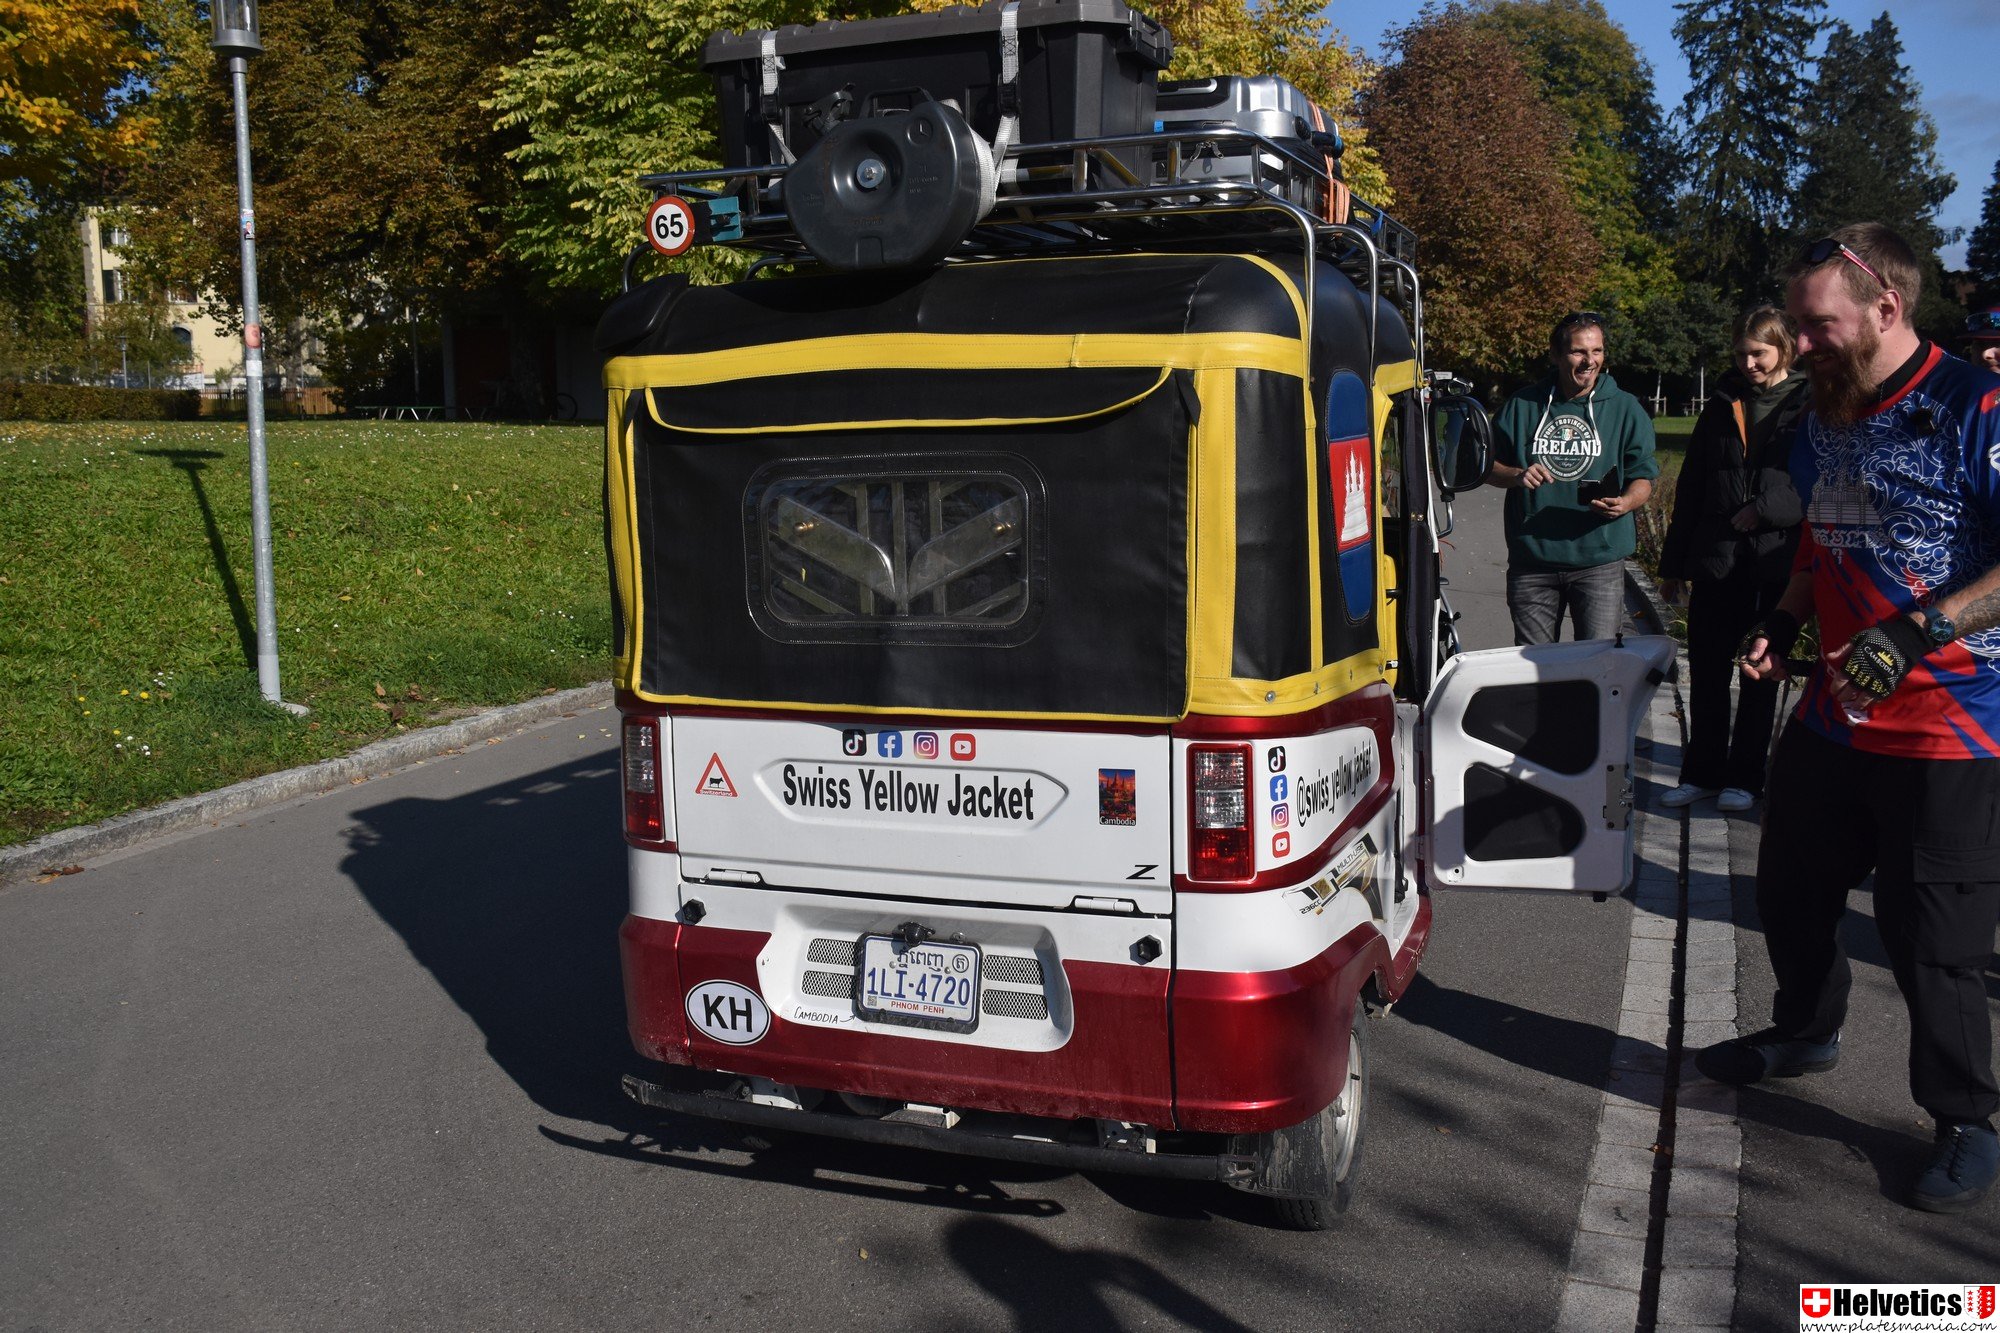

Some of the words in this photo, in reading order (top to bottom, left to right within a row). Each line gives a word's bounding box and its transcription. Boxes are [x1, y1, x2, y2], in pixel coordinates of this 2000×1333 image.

[655, 213, 684, 239] 65
[1531, 438, 1602, 457] IRELAND
[1864, 646, 1895, 676] CAMBODIA
[783, 764, 851, 809] Swiss
[858, 768, 939, 814] Yellow
[947, 773, 1034, 820] Jacket
[1296, 738, 1371, 827] @swiss_yellow_jacket
[1100, 816, 1136, 826] Cambodia
[1336, 843, 1364, 871] MULTI-USE
[1126, 864, 1159, 880] Z
[1299, 899, 1321, 914] 236CC
[867, 967, 971, 1006] 1LI-4720
[702, 993, 753, 1032] KH
[794, 1006, 839, 1024] CAMBODIA
[890, 1000, 919, 1011] PHNOM
[923, 1005, 945, 1014] PENH
